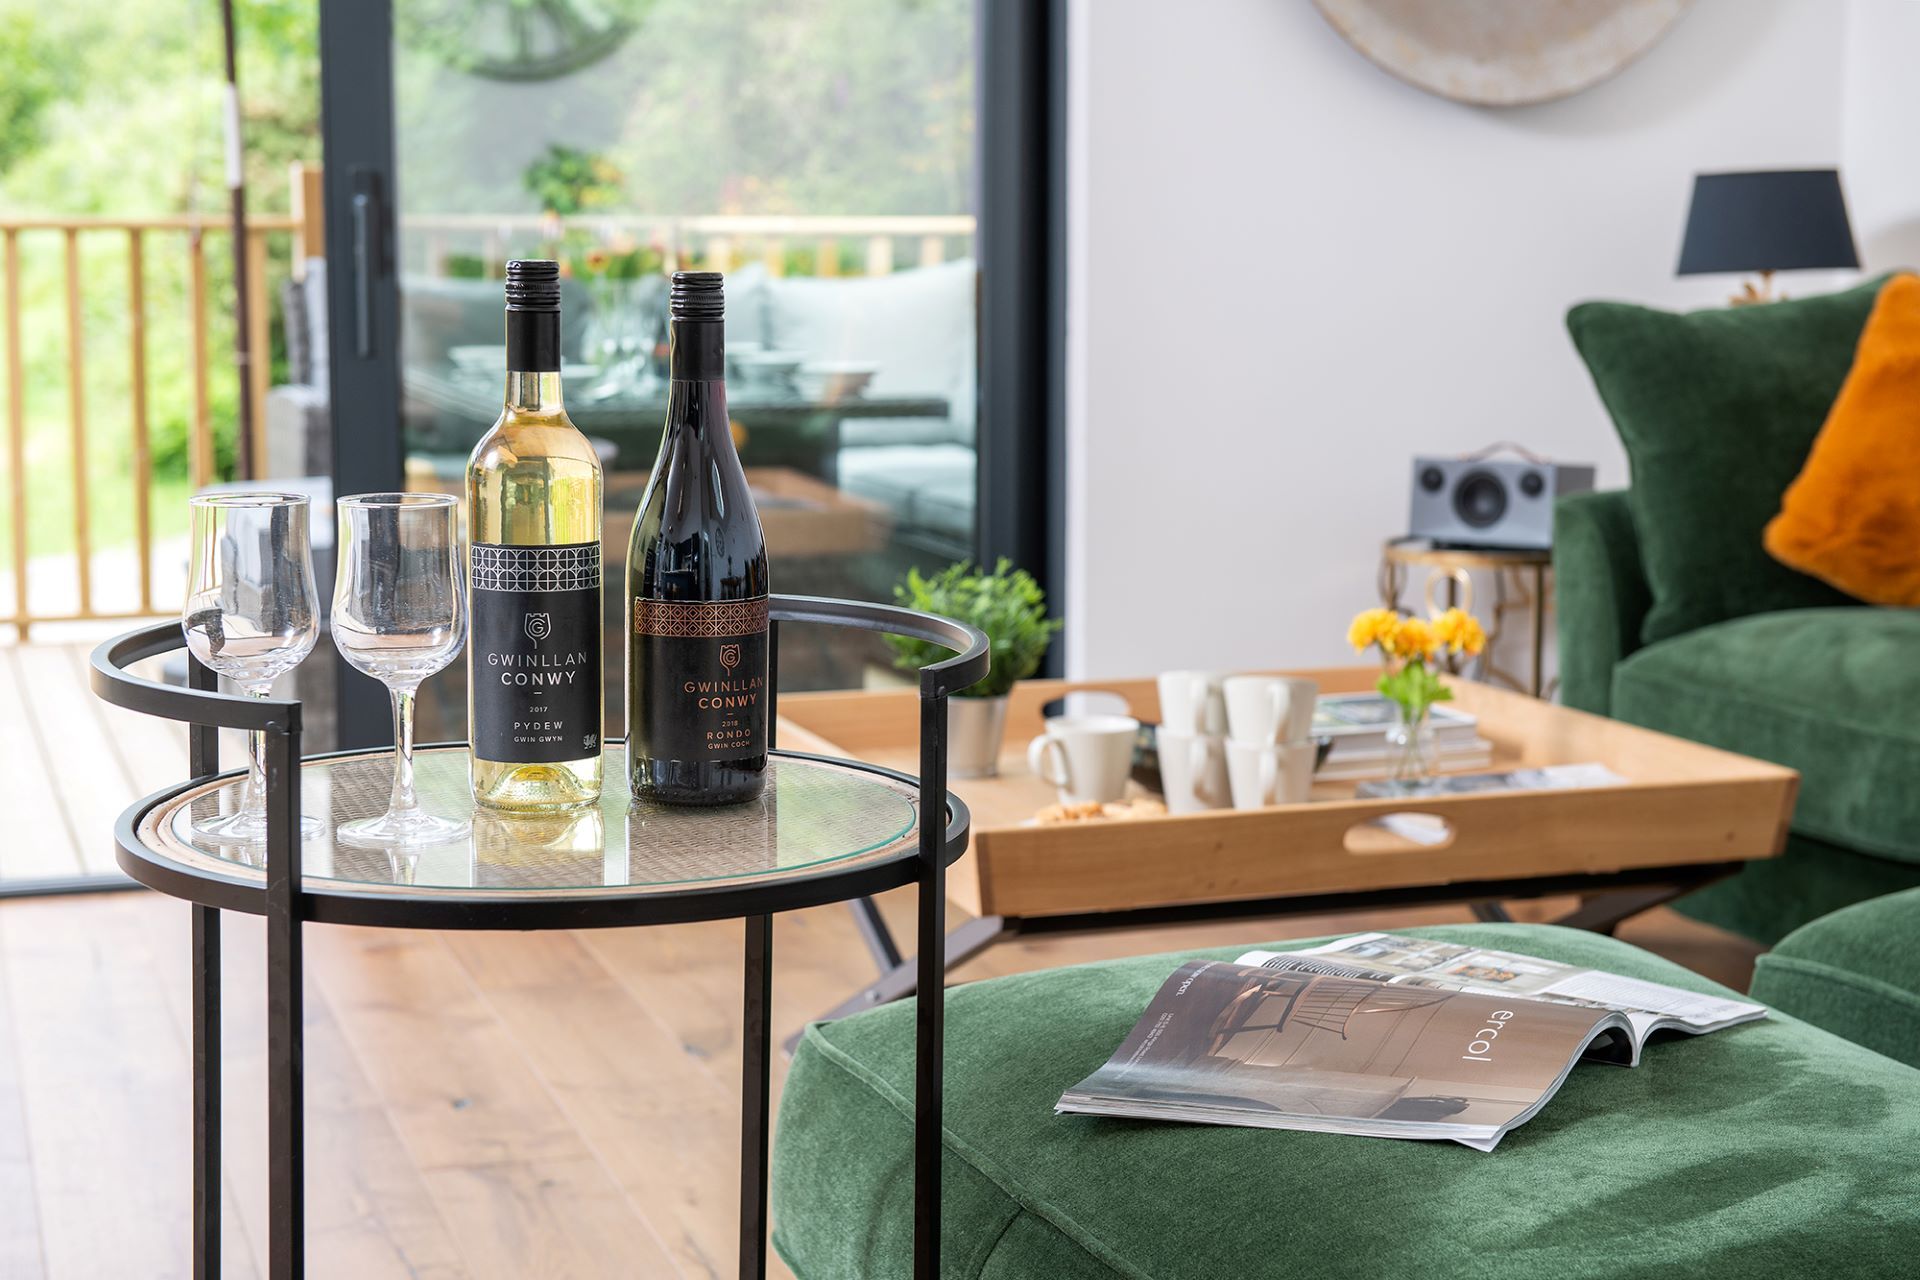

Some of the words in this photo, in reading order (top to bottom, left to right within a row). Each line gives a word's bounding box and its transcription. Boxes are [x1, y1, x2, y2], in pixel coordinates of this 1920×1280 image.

[487, 651, 587, 667] GWINLLAN
[501, 670, 576, 686] CONWY
[684, 676, 763, 693] GWINLLAN
[698, 693, 757, 709] CONWY
[513, 721, 563, 730] PYDEW
[538, 735, 563, 743] GWYN
[706, 728, 751, 740] RONDO
[707, 742, 729, 750] GWIN
[731, 740, 751, 749] COCH
[1462, 1010, 1514, 1062] ercol
